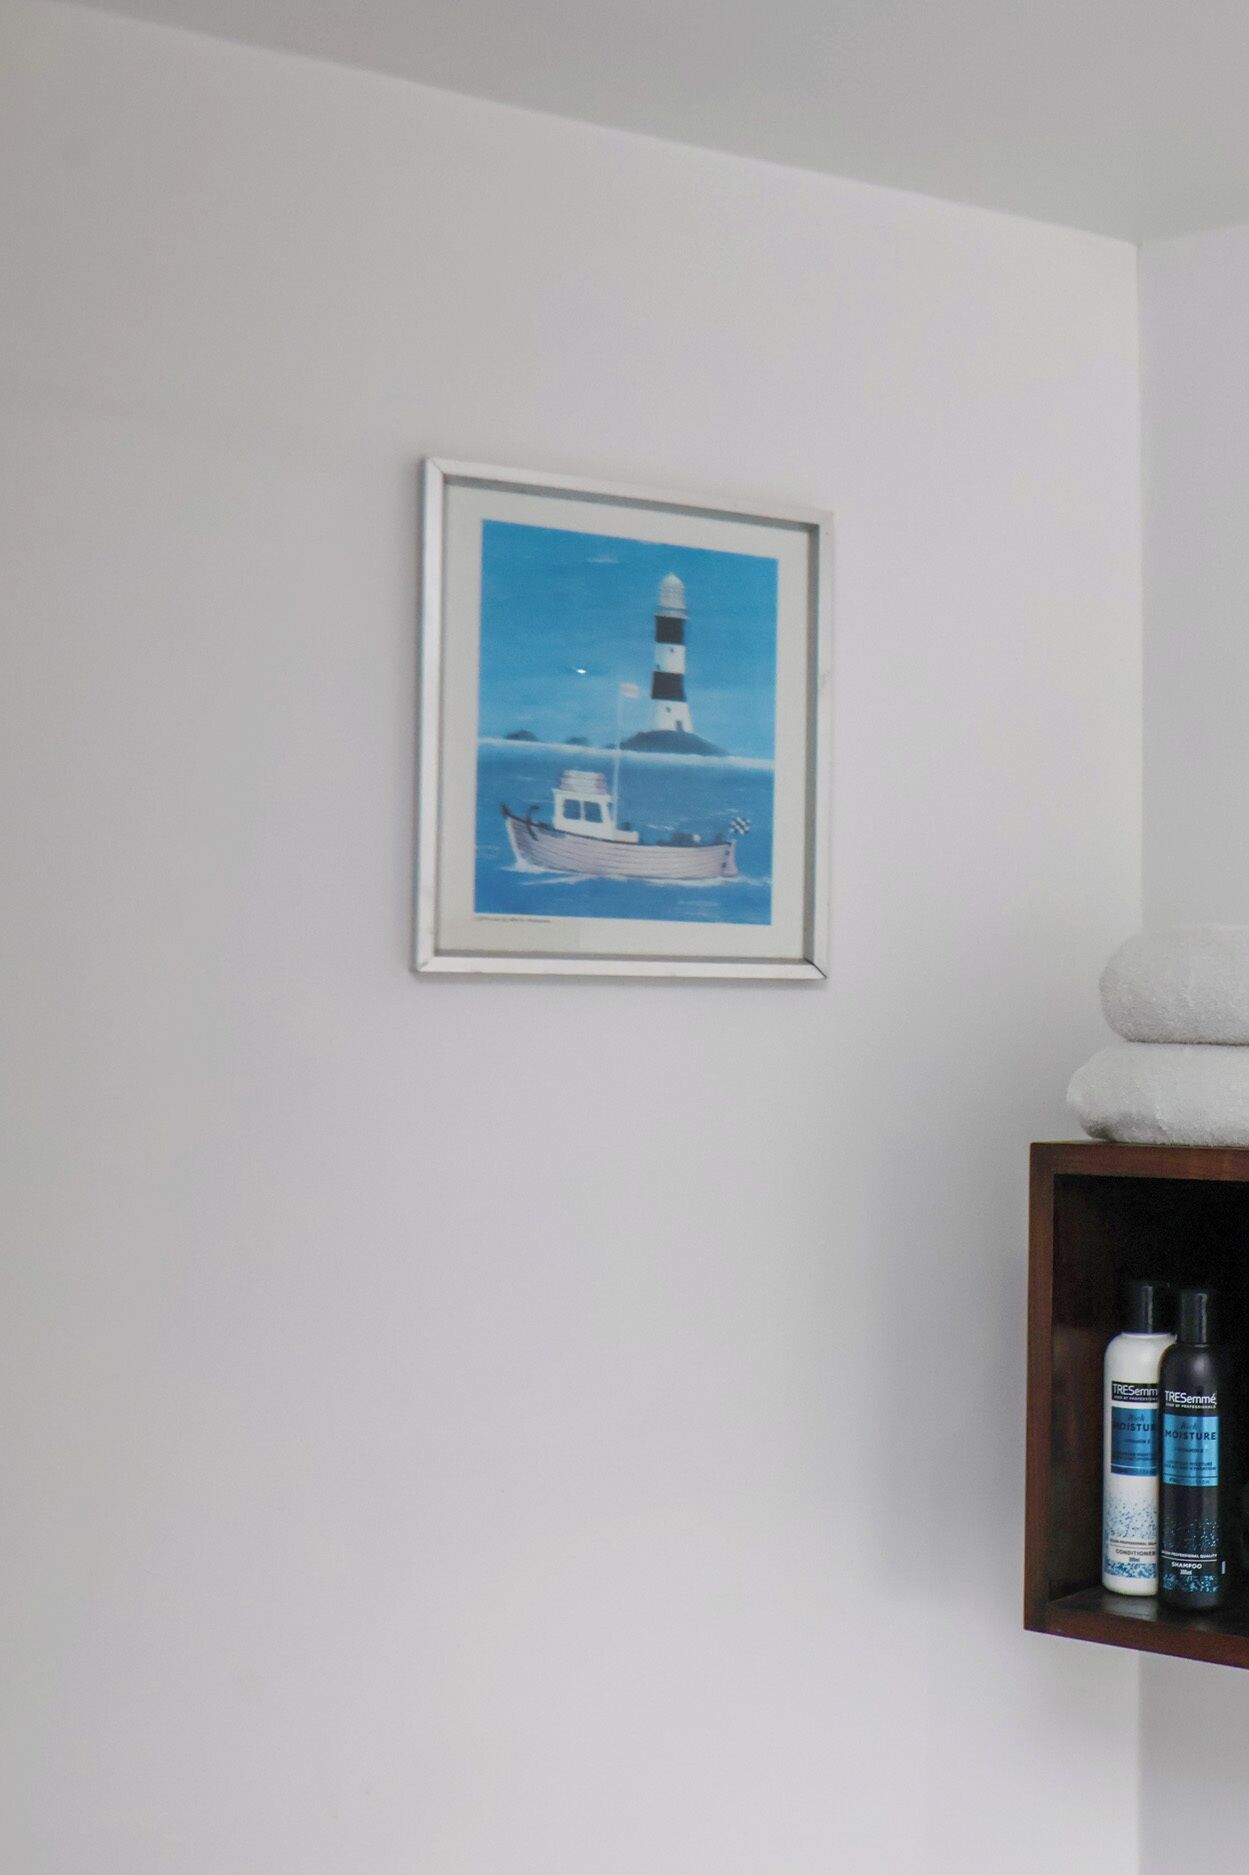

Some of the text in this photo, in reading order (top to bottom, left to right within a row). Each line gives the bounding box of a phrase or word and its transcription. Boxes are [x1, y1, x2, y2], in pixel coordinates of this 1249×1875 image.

[1113, 1384, 1158, 1396] TRESemm
[1165, 1430, 1217, 1441] MOISTURE
[1115, 1548, 1156, 1556] CONDITIONER
[1171, 1561, 1203, 1570] SHAMPOO
